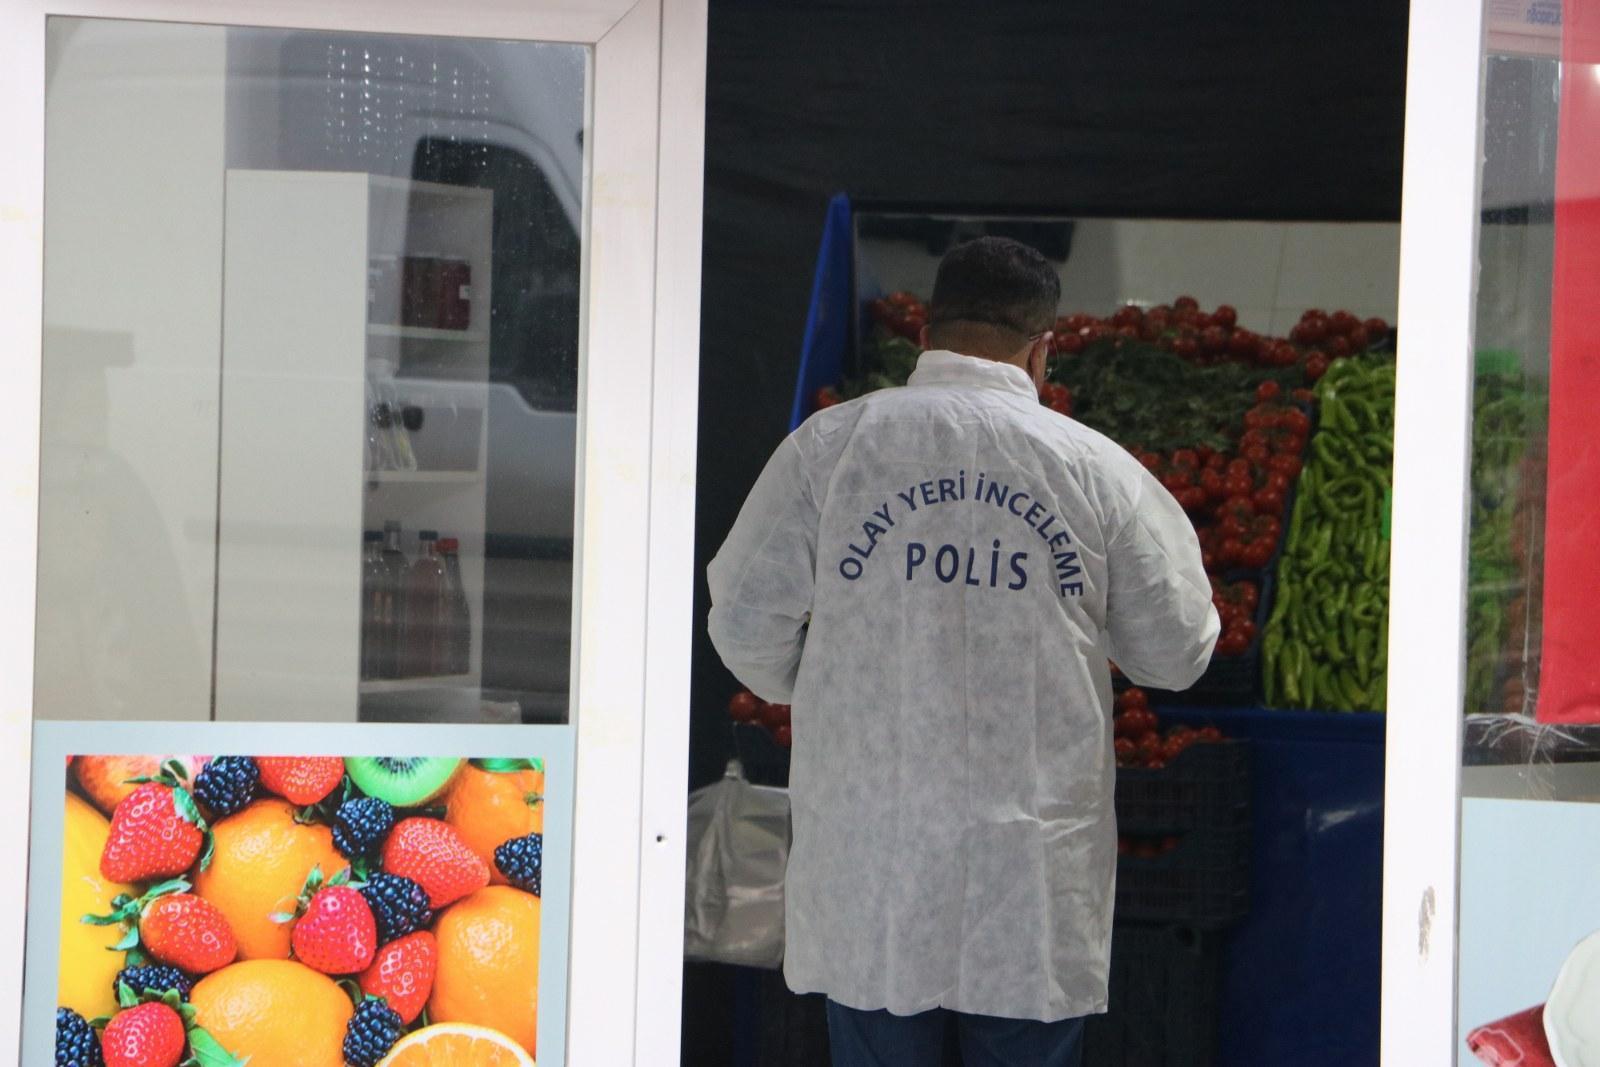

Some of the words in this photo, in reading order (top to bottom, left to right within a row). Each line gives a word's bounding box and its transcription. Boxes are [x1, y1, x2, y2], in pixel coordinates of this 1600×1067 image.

[839, 502, 895, 581] OLAY
[898, 470, 965, 511] YERİ
[974, 472, 1083, 598] İNCELEME
[906, 539, 1027, 591] POLİS
